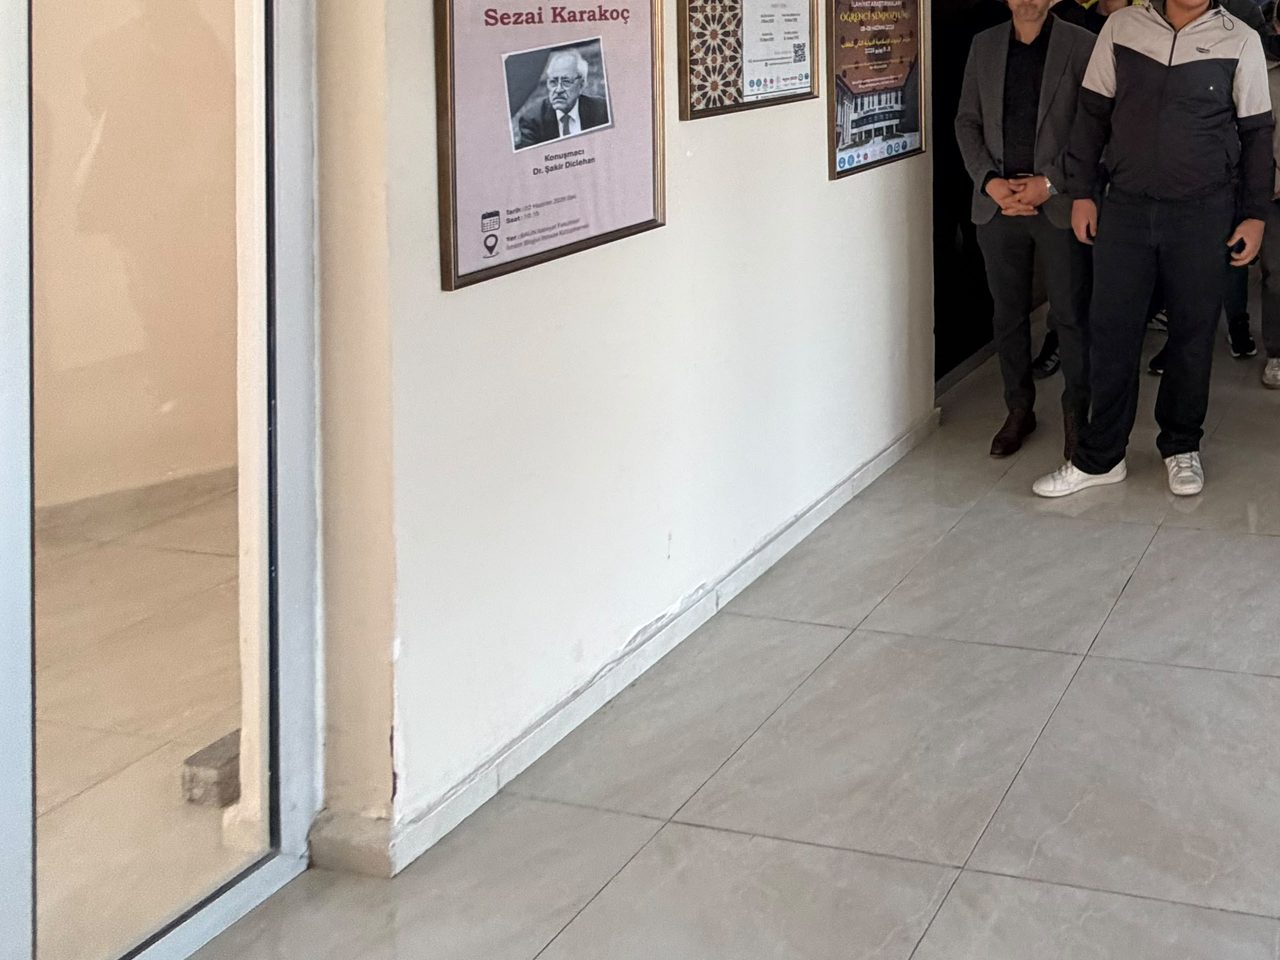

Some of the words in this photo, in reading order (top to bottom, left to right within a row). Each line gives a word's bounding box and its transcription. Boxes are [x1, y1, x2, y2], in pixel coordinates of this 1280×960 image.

[484, 6, 544, 27] Sezai
[550, 5, 630, 25] Karakoç
[544, 148, 585, 162] Konuşmacı
[533, 167, 544, 176] Dr.
[544, 163, 564, 175] Şakir
[565, 157, 596, 169] Diclehan
